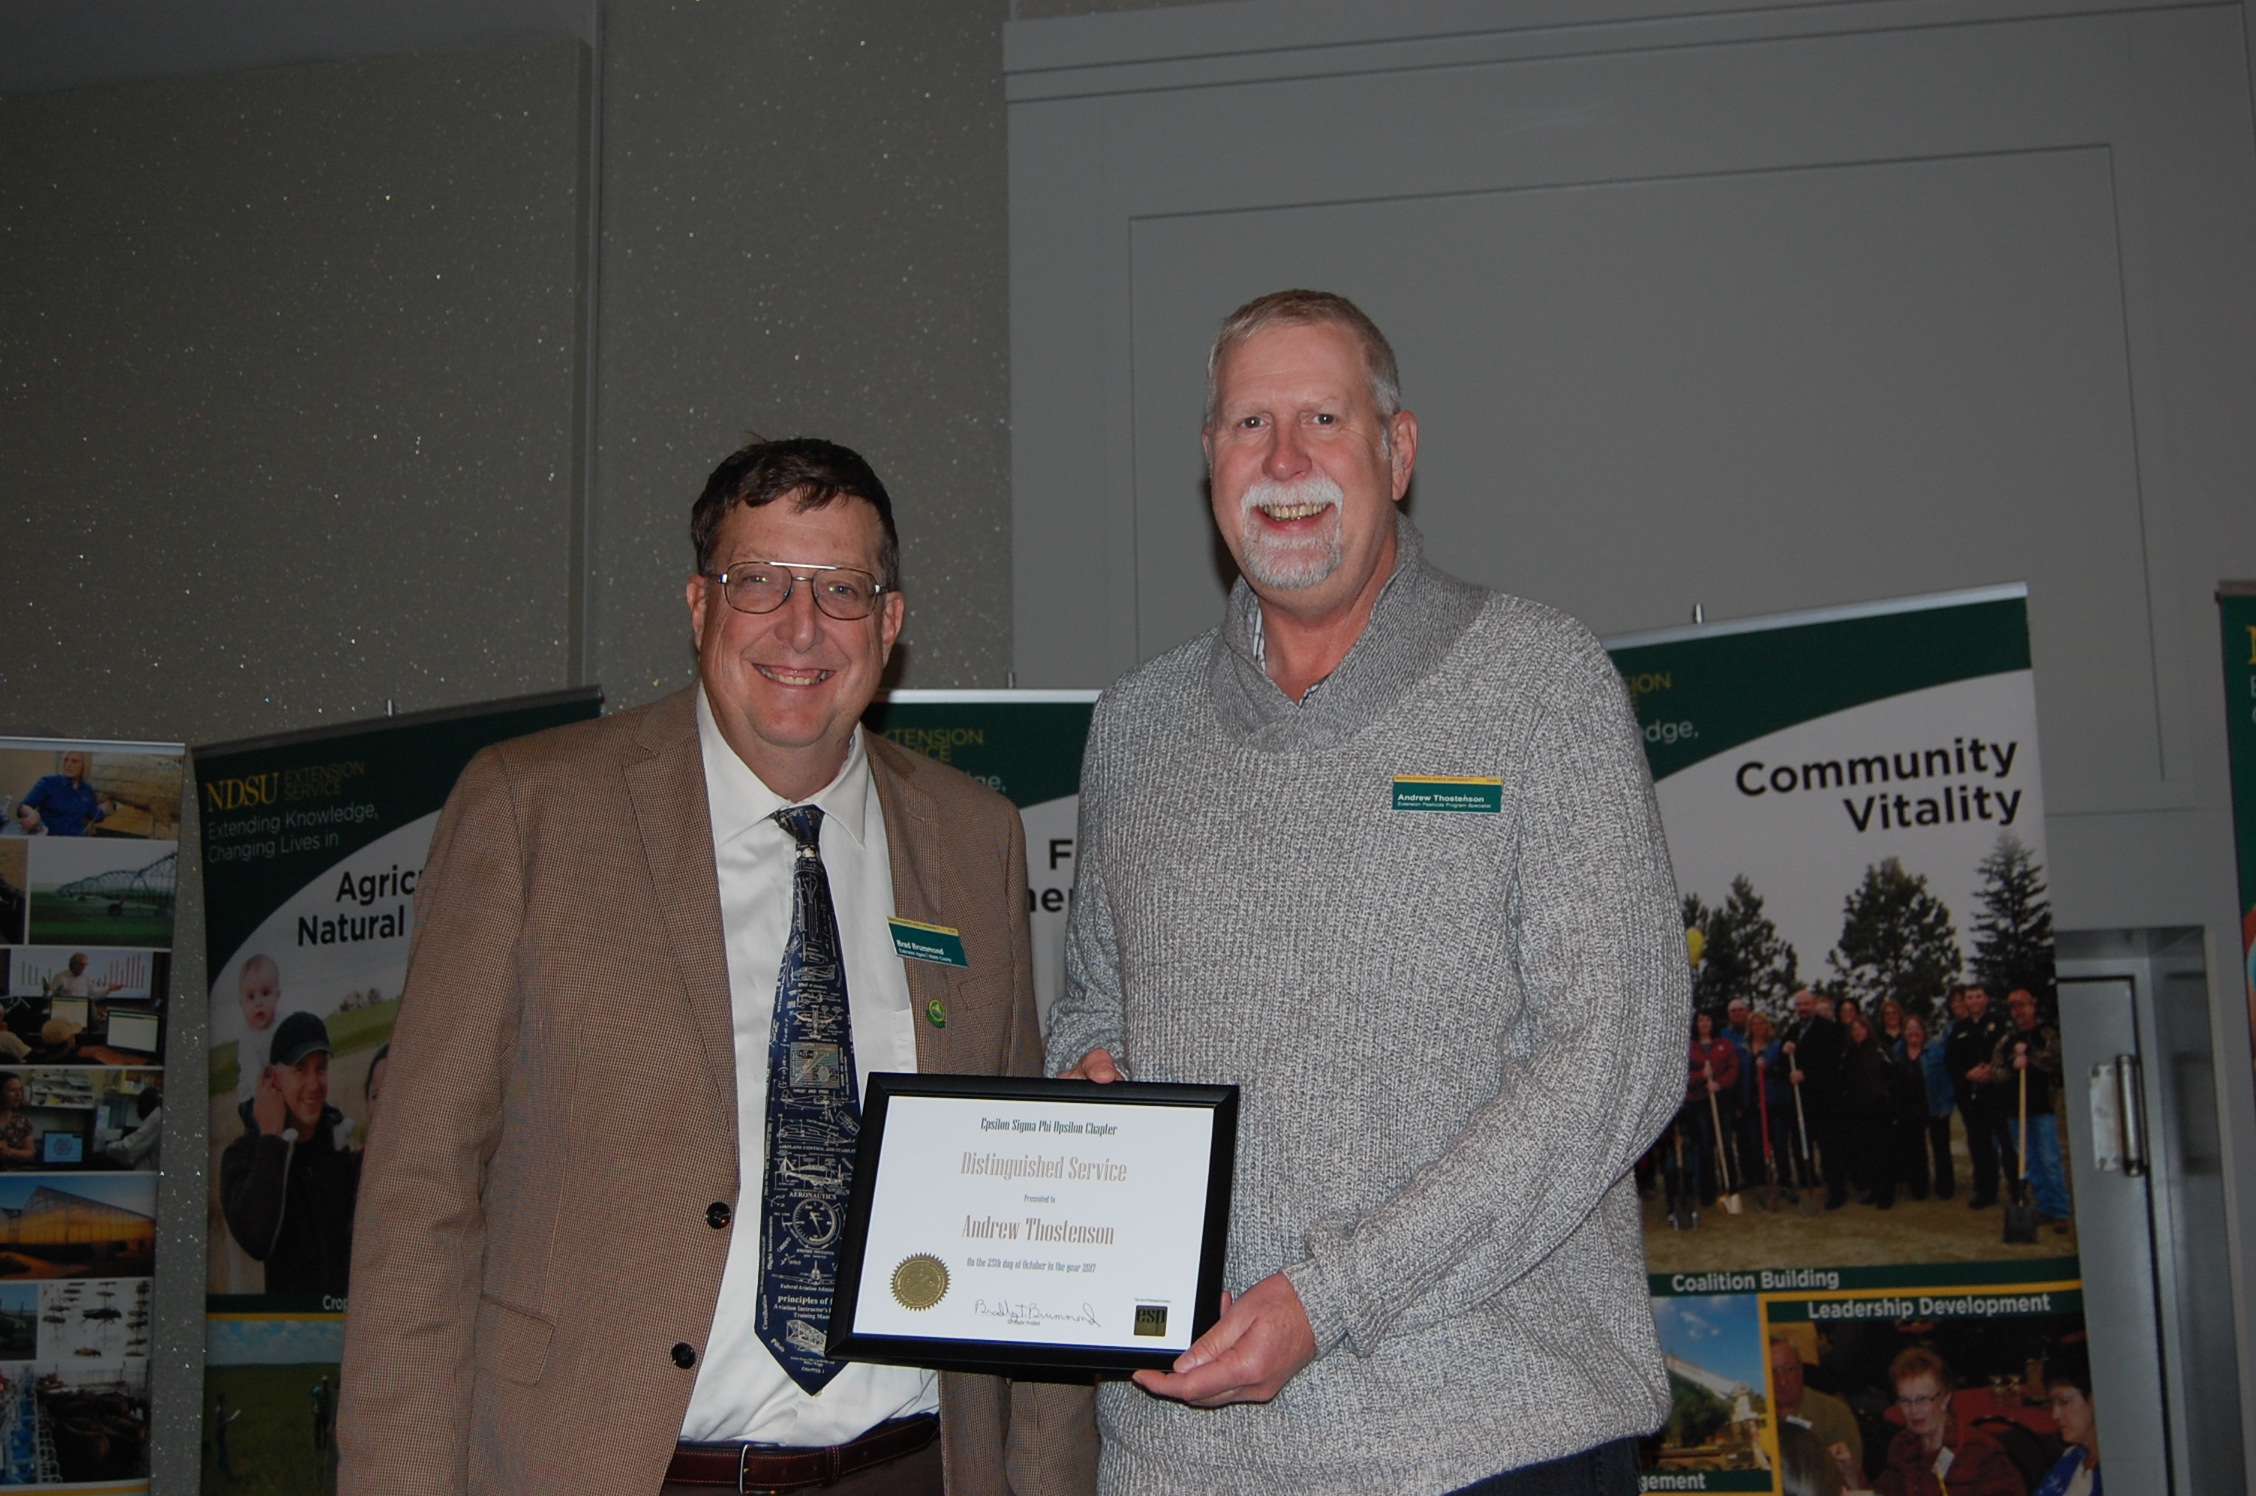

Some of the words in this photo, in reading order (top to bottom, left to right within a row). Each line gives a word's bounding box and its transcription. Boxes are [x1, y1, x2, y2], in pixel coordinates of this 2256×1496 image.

[1736, 738, 2018, 797] Community
[206, 772, 280, 813] NDSU
[284, 761, 365, 782] EXTENSION
[284, 780, 342, 801] SERVICE
[1398, 794, 1431, 802] Andrew
[1433, 794, 1485, 803] Thostenson
[208, 815, 280, 840] Extending
[285, 802, 378, 827] Knowledge,
[1844, 787, 2022, 833] Vitality
[208, 840, 276, 863] Changing
[281, 835, 320, 854] Lives
[325, 831, 339, 847] in
[298, 905, 405, 946] Natural
[897, 939, 911, 949] Brad
[912, 942, 944, 955] Brummond
[981, 1117, 1010, 1132] Epsilon
[1011, 1119, 1036, 1134] Sigma
[1038, 1119, 1052, 1133] Phi
[1054, 1120, 1083, 1135] Upsilon
[1085, 1122, 1117, 1137] Chapter
[960, 1151, 1065, 1181] Distinguished
[1068, 1156, 1127, 1182] Service
[789, 1191, 837, 1200] AERONAUTICS
[1024, 1194, 1049, 1203] Presented
[1050, 1195, 1055, 1203] to
[962, 1215, 1020, 1240] Andrew
[1025, 1217, 1114, 1245] Thostenson
[967, 1257, 975, 1267] On
[976, 1257, 986, 1267] the
[1002, 1259, 1013, 1270] day
[1014, 1259, 1021, 1269] of
[1022, 1259, 1046, 1270] October
[1048, 1261, 1054, 1270] in
[1055, 1261, 1065, 1271] the
[1066, 1263, 1081, 1273] year
[1082, 1263, 1096, 1273] 2017
[1671, 1273, 1755, 1293] Coalition
[1760, 1270, 1840, 1291] Building
[777, 1294, 818, 1305] principles
[819, 1297, 829, 1305] of
[1807, 1297, 1914, 1320] Leadership
[1919, 1293, 2051, 1316] Development
